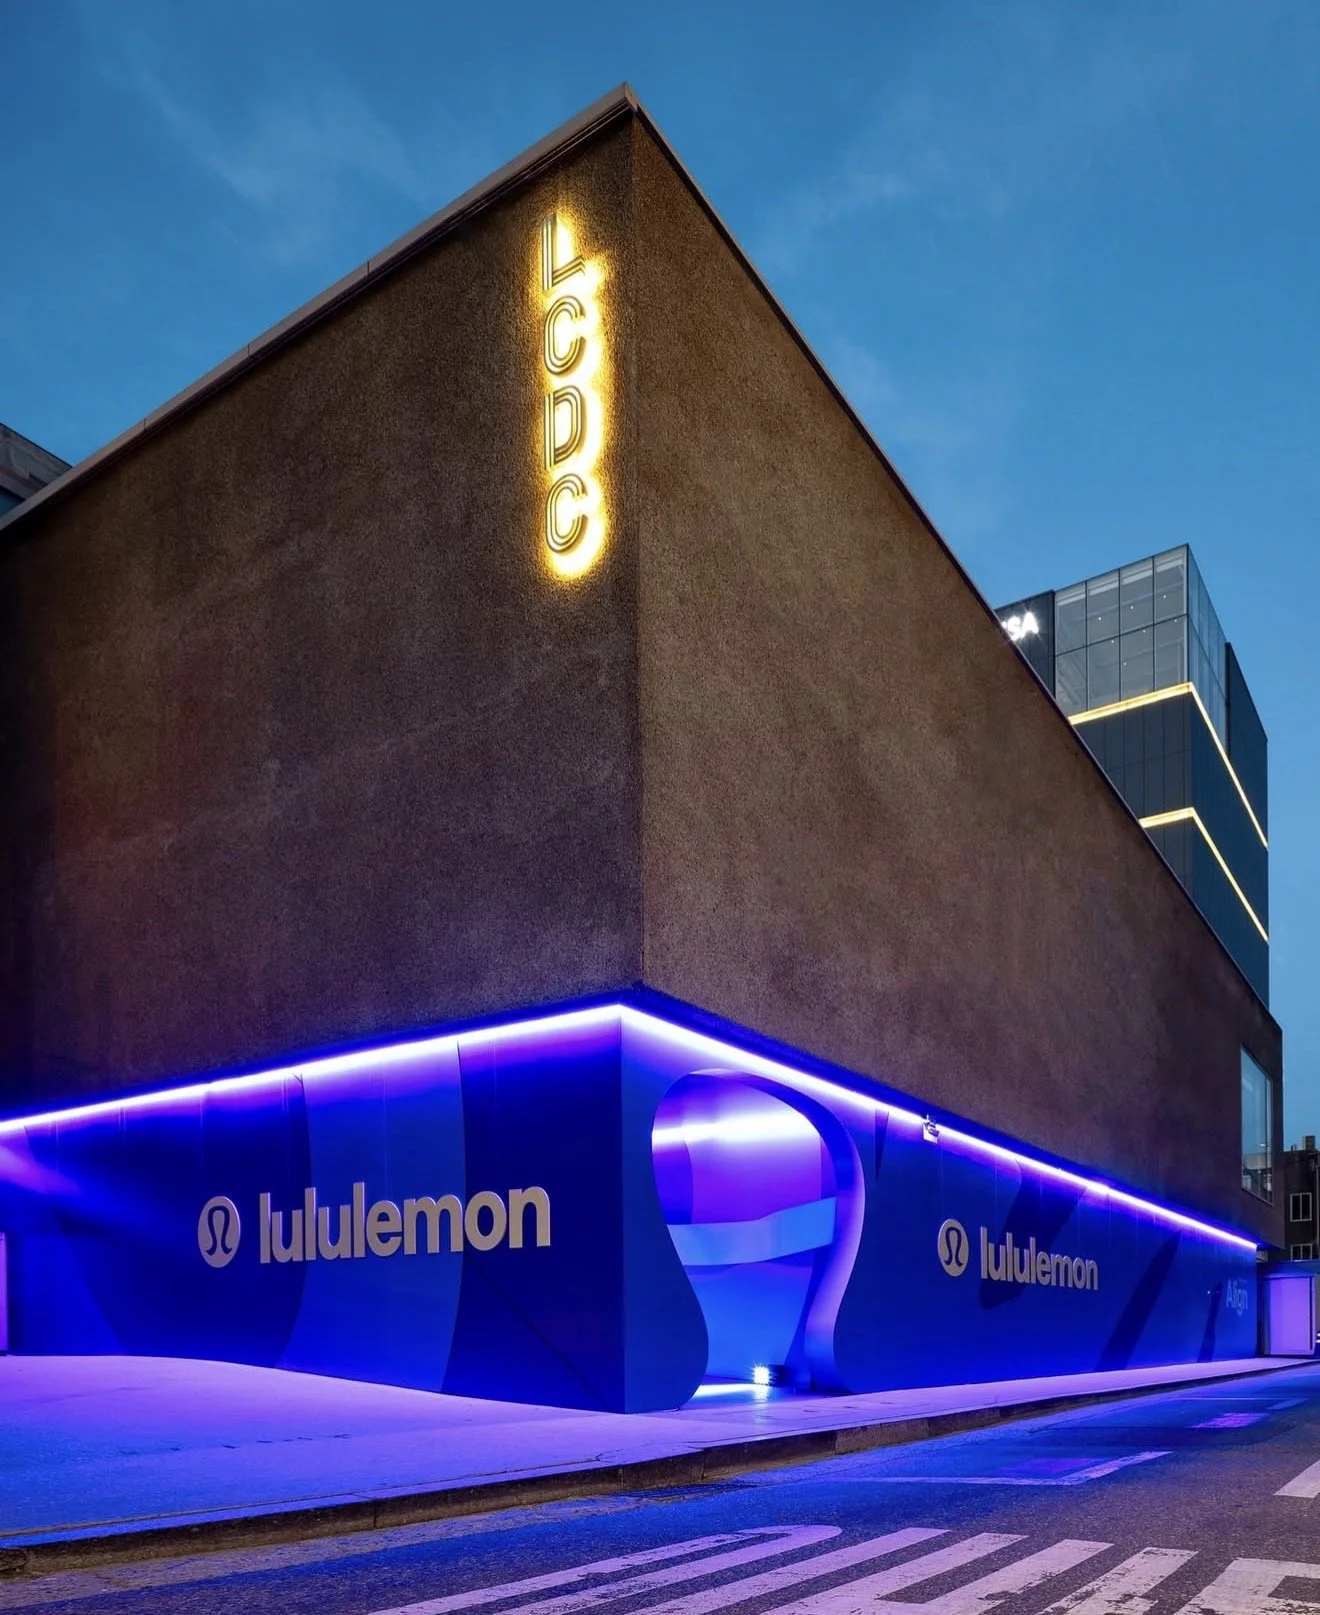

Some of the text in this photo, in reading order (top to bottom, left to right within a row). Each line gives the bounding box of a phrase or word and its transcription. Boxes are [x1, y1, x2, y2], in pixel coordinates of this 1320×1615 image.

[541, 213, 588, 554] LCDC
[259, 1181, 551, 1264] lululemon
[980, 1226, 1098, 1291] lululemon
[1226, 1277, 1249, 1316] Align
